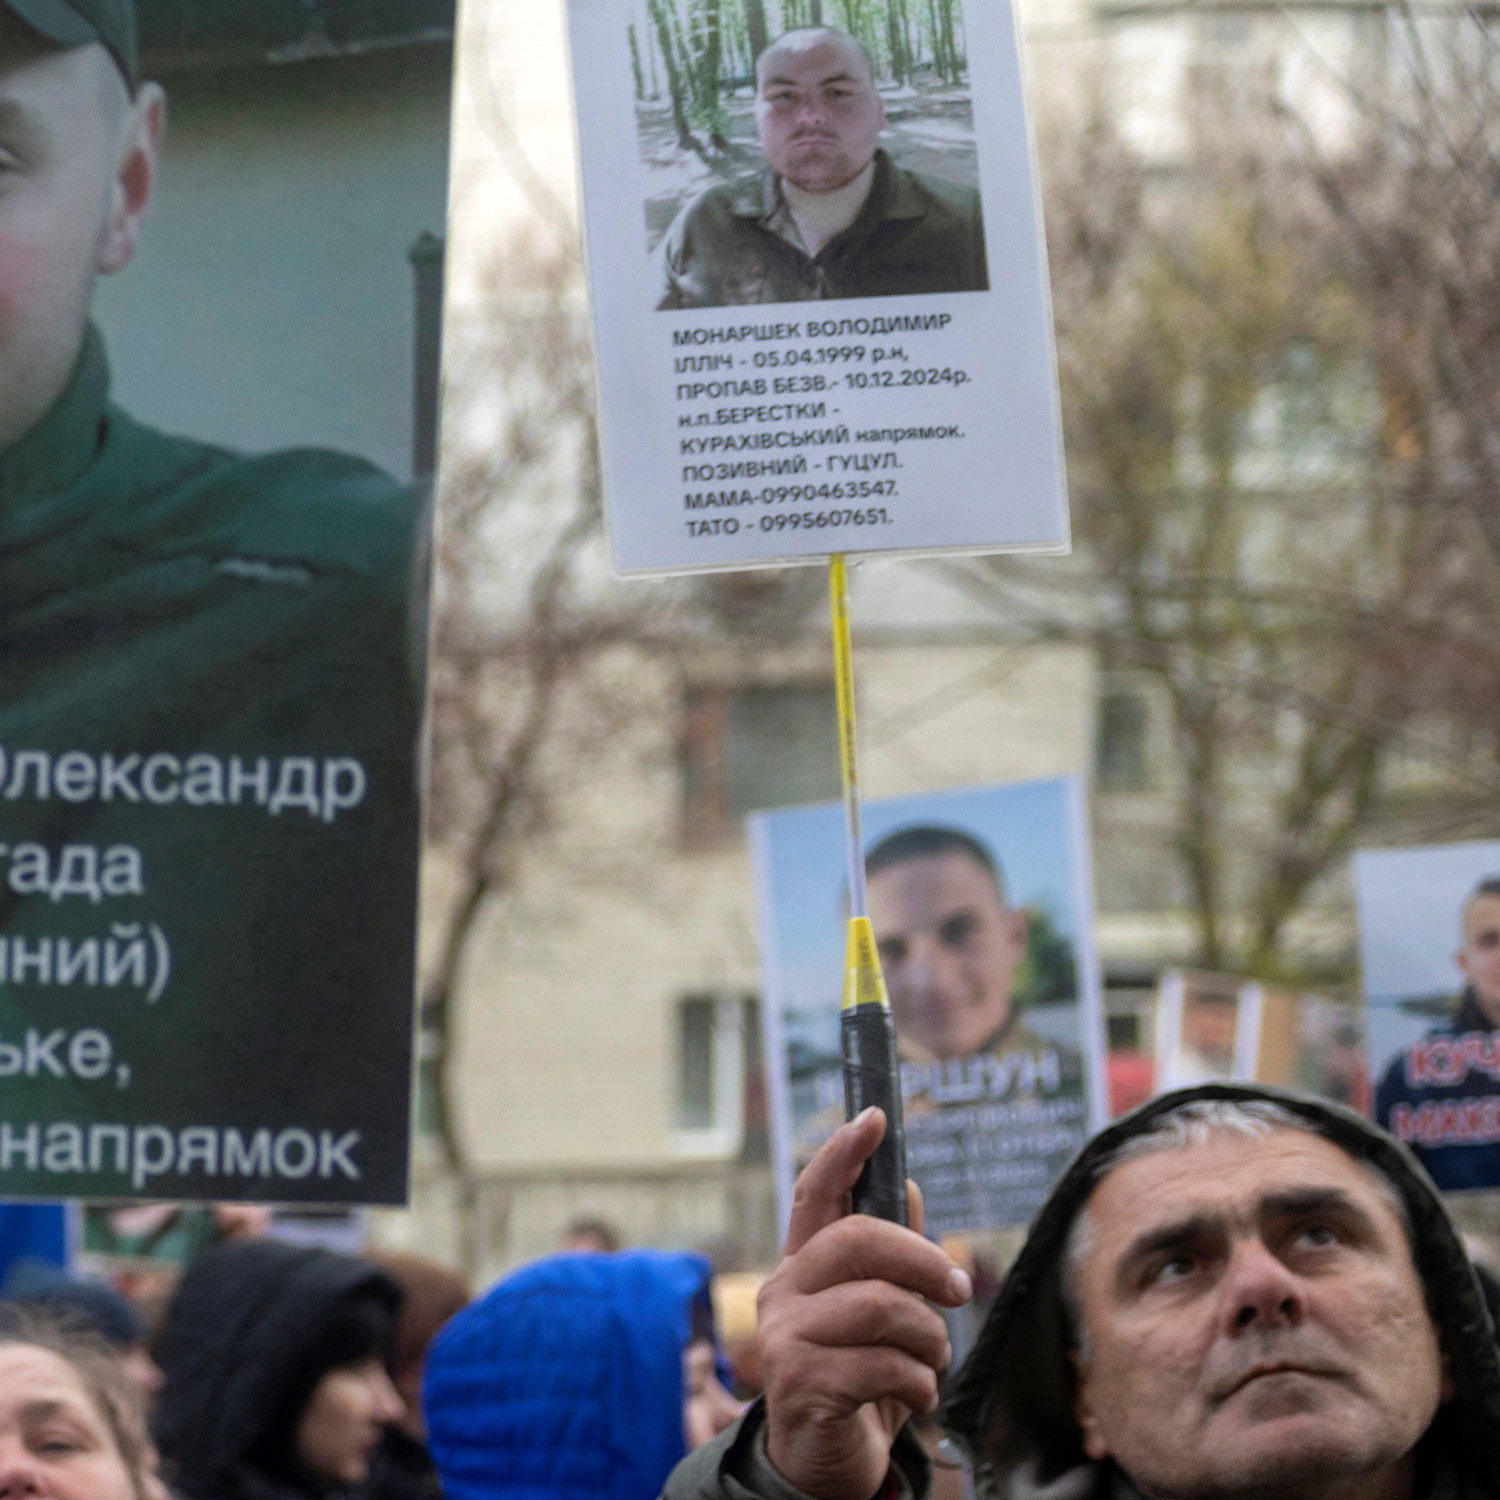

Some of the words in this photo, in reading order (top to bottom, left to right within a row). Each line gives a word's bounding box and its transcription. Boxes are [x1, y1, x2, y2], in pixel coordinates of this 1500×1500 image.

[672, 321, 803, 348] МОНАРШЕК
[807, 313, 952, 340] ВОЛОДИМИР
[753, 345, 867, 370] 05.04.1999
[676, 378, 768, 400] ПРОПАВ
[844, 366, 972, 389] 10.12.2024р.
[680, 424, 851, 455] КУРАХІВСЬКИЙ
[856, 424, 966, 446] напрямок.
[682, 456, 808, 483] ПОЗИВНИЙ
[686, 517, 740, 537] ТАТО
[0, 1122, 360, 1186] напрямок
